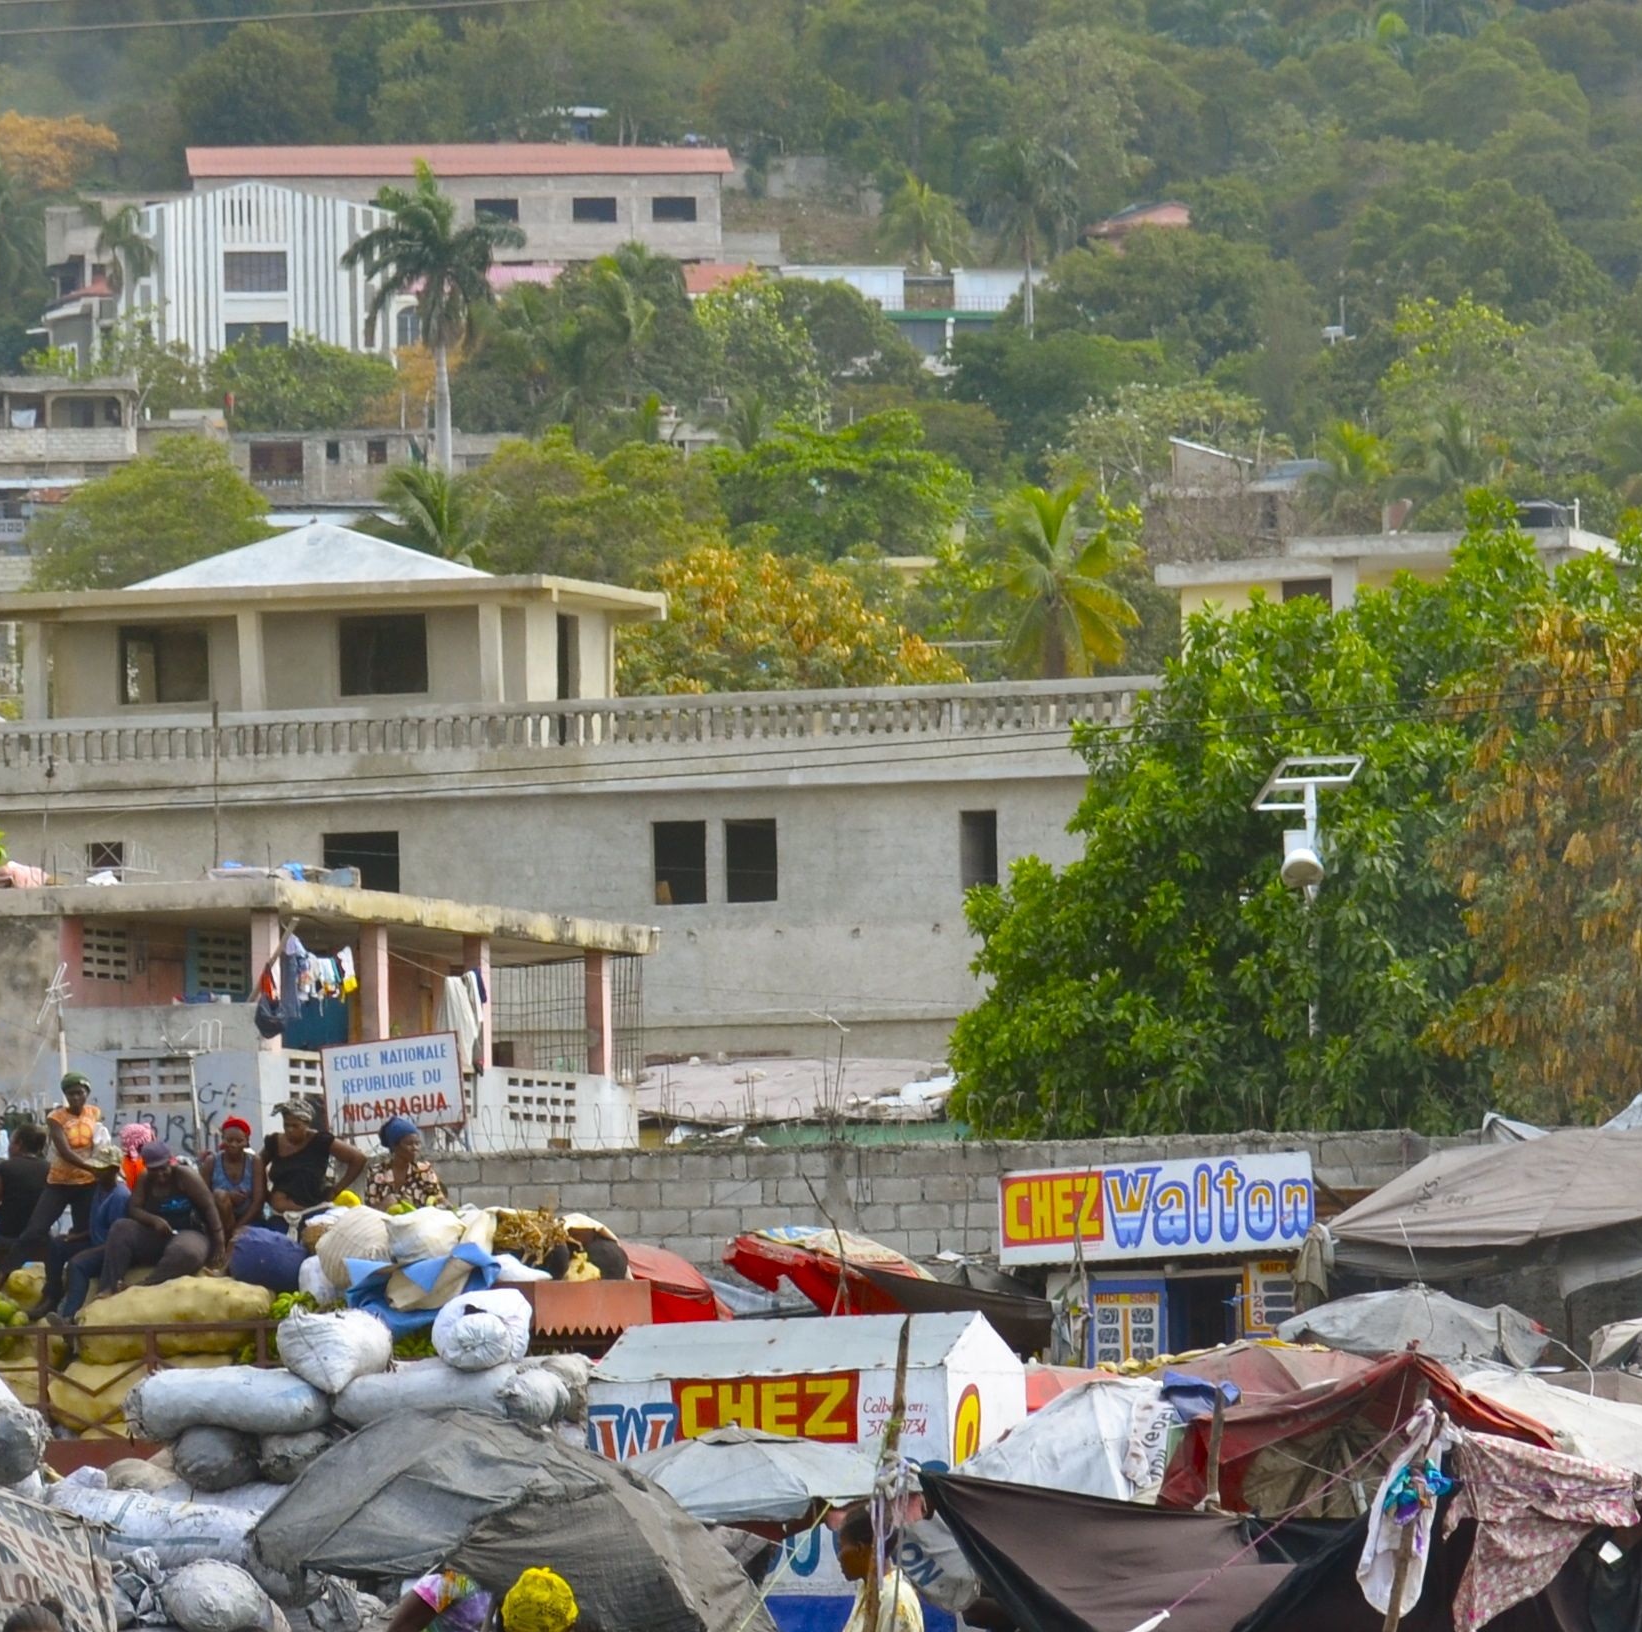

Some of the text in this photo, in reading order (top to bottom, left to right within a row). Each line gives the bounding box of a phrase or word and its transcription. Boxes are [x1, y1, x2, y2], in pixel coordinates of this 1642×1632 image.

[334, 1043, 447, 1072] ECOLE NATIONALE
[342, 1068, 442, 1094] REPUBLIQUE DU
[342, 1091, 448, 1122] NICARAGUA
[1005, 1160, 1315, 1249] CHEZ Walton
[680, 1378, 851, 1440] CHEZ
